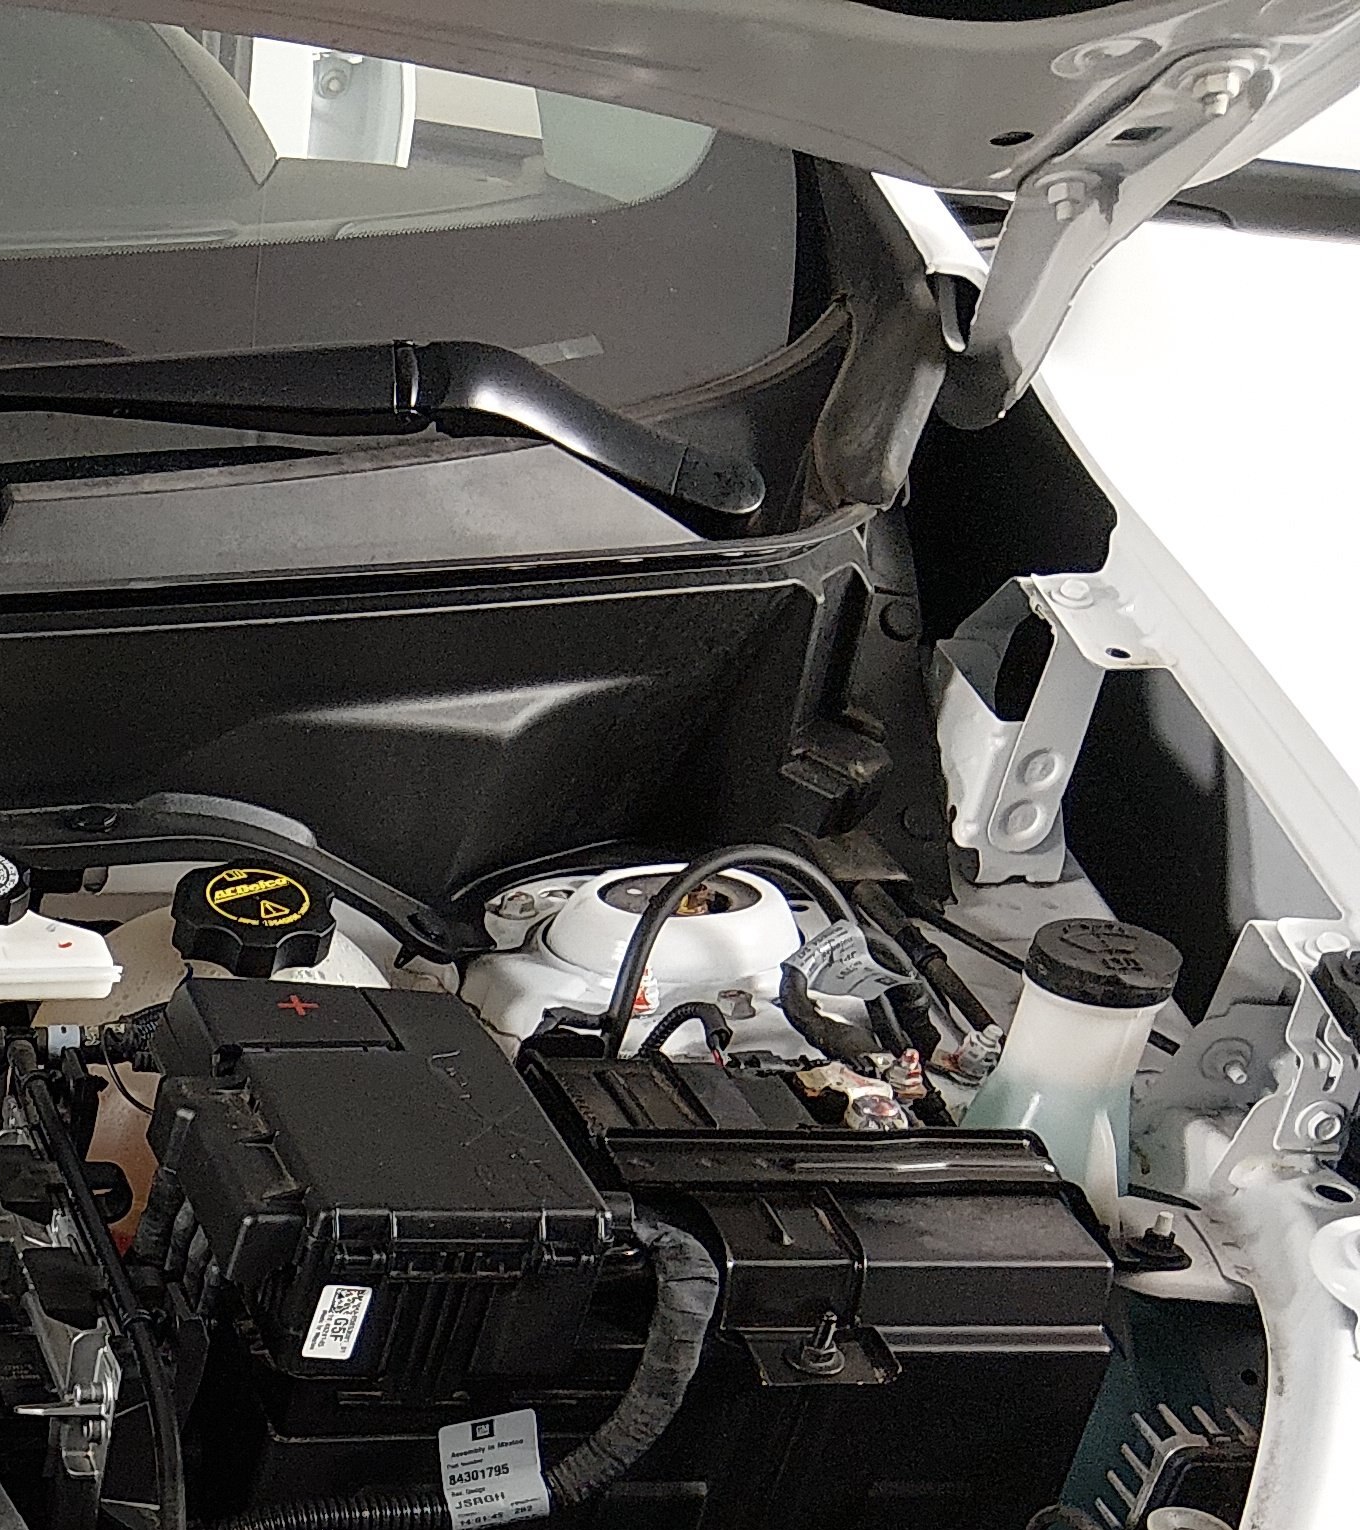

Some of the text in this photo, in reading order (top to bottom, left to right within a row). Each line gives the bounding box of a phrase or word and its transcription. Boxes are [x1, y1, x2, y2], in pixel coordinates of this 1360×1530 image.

[214, 877, 288, 900] ACDelco
[329, 1317, 349, 1342] G5F
[448, 1462, 510, 1486] 84301795
